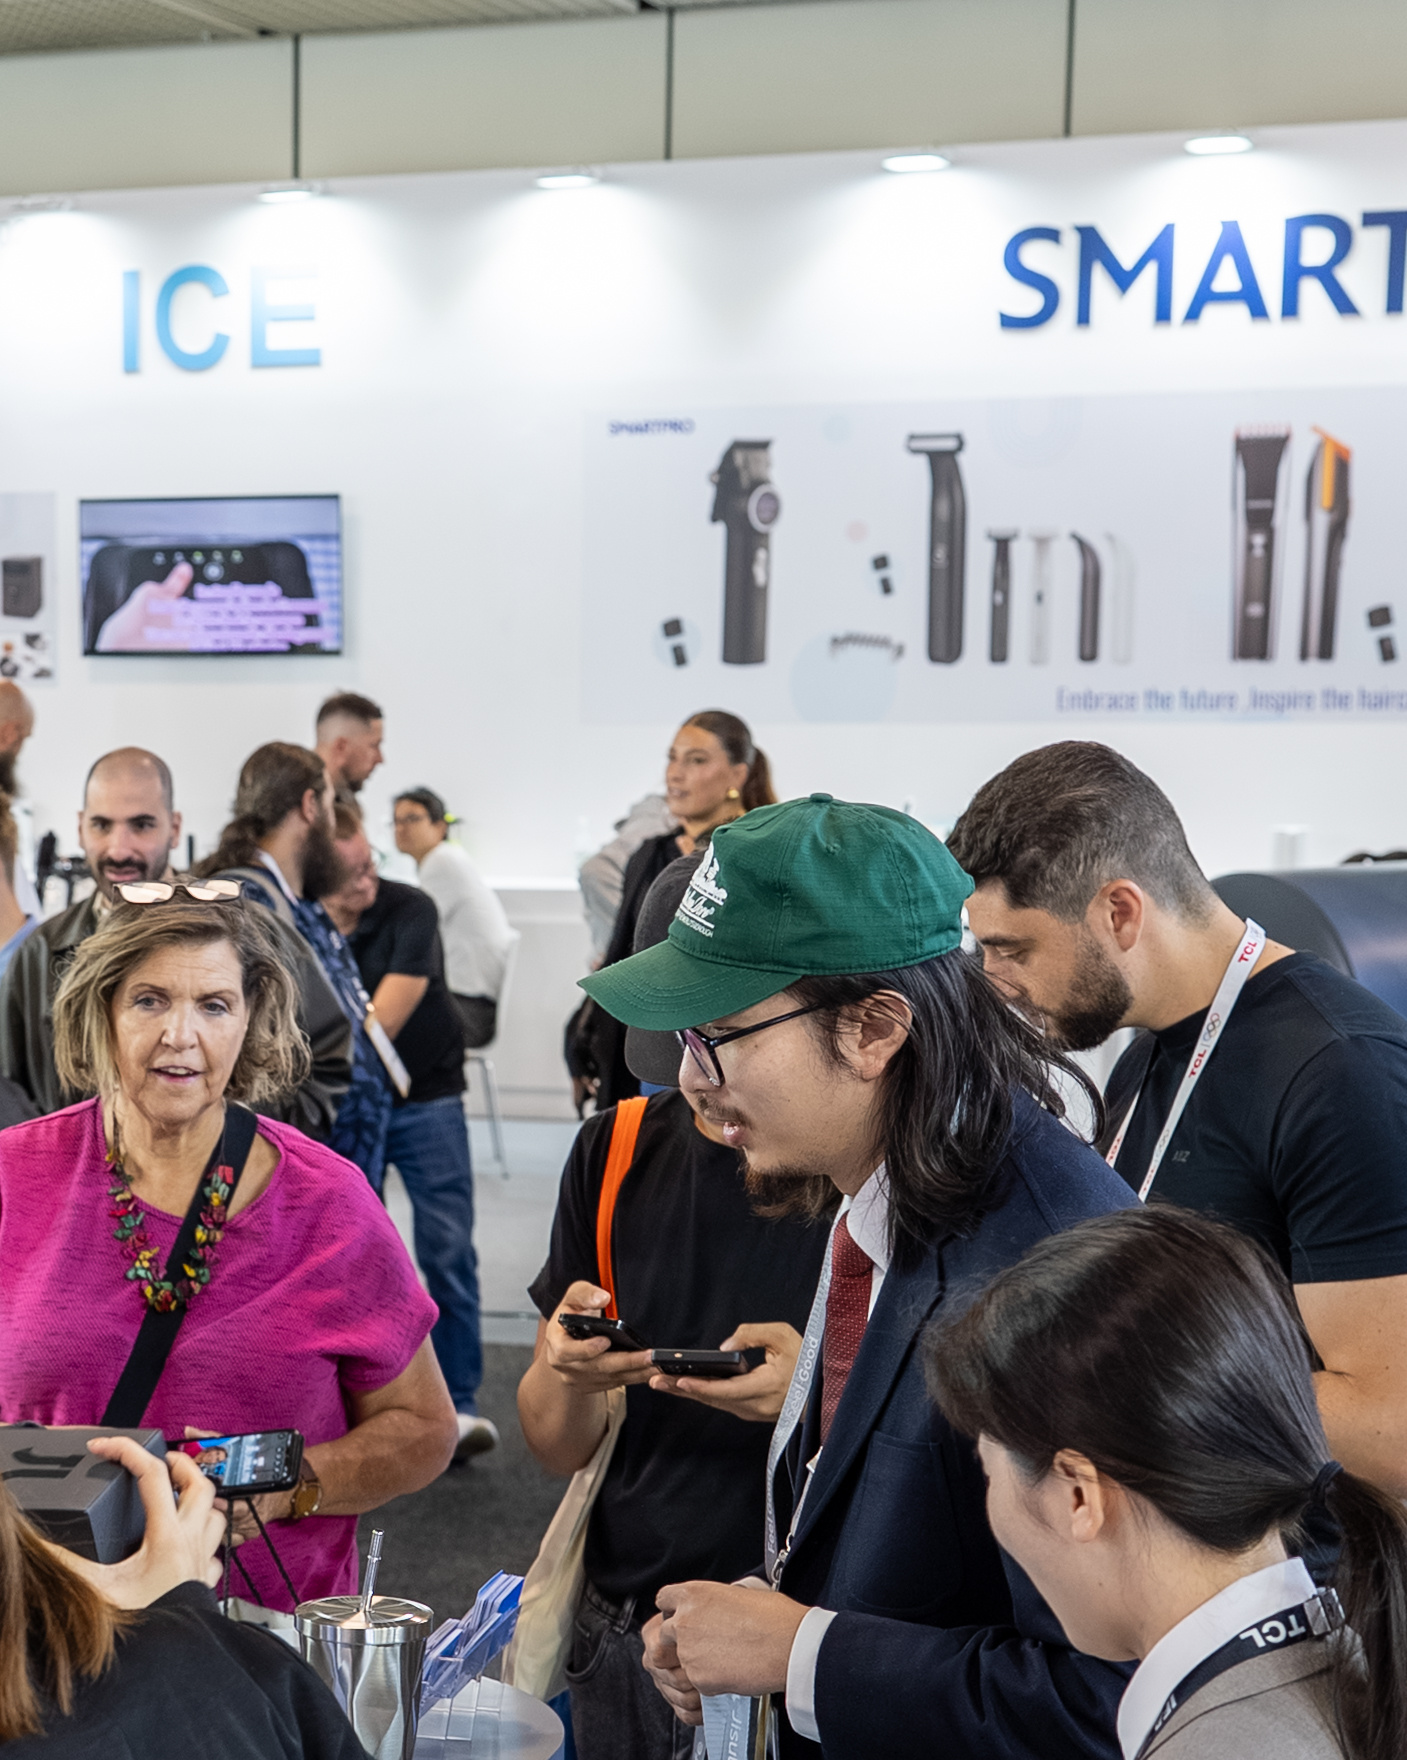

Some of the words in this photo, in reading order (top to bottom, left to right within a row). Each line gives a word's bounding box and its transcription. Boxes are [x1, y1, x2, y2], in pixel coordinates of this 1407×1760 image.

[997, 210, 1407, 332] SMART
[121, 263, 323, 375] ICE
[1238, 940, 1258, 963] TCL
[1188, 1048, 1207, 1079] TCL
[798, 1336, 819, 1385] Good
[1239, 1614, 1306, 1649] TCL
